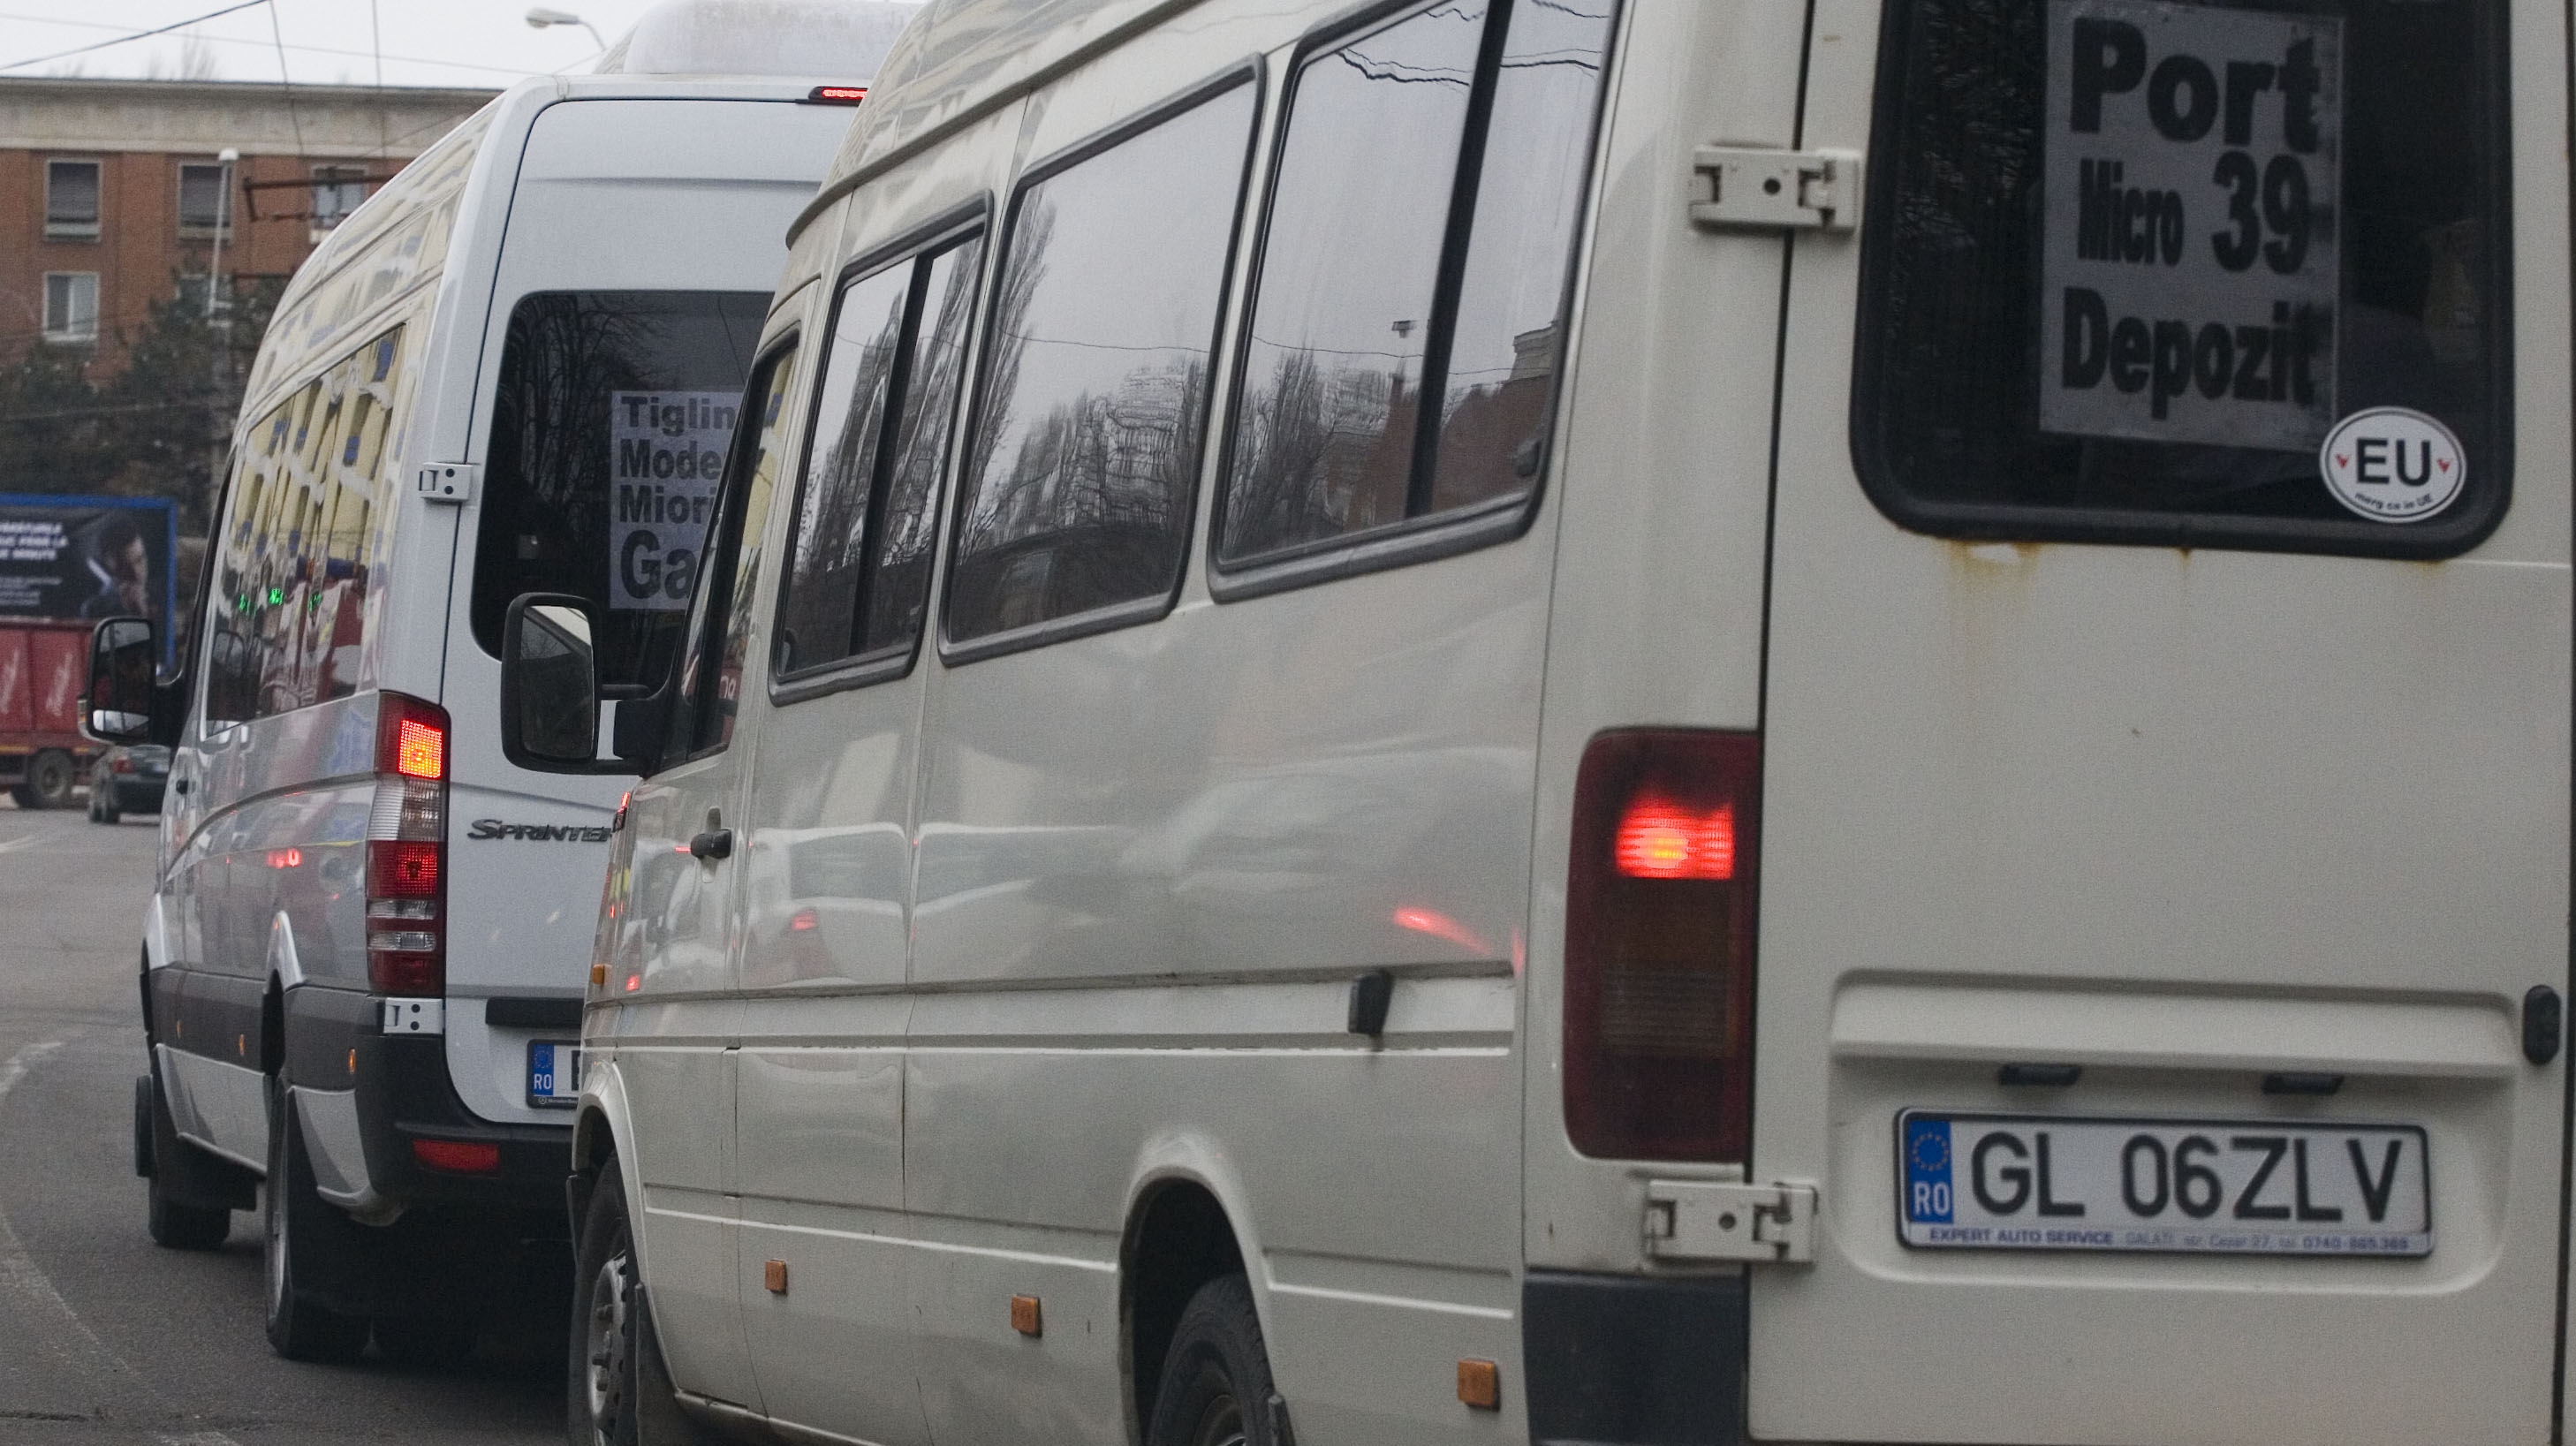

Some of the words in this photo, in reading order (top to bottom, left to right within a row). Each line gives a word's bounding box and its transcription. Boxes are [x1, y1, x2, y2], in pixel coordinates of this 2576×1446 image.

[2070, 17, 2321, 154] Port
[2077, 158, 2186, 266] Micro
[2211, 150, 2310, 275] 39
[2061, 285, 2319, 421] Depozit
[619, 439, 726, 480] Mode
[2355, 437, 2432, 488] EU
[534, 1073, 552, 1090] RO
[1913, 1181, 1951, 1216] RO
[1971, 1131, 2086, 1217] GL
[2122, 1133, 2403, 1223] 06ZLV
[1929, 1227, 1991, 1243] EXPERT
[1996, 1229, 2042, 1244] AUTO
[2046, 1230, 2113, 1245] SERVICE
